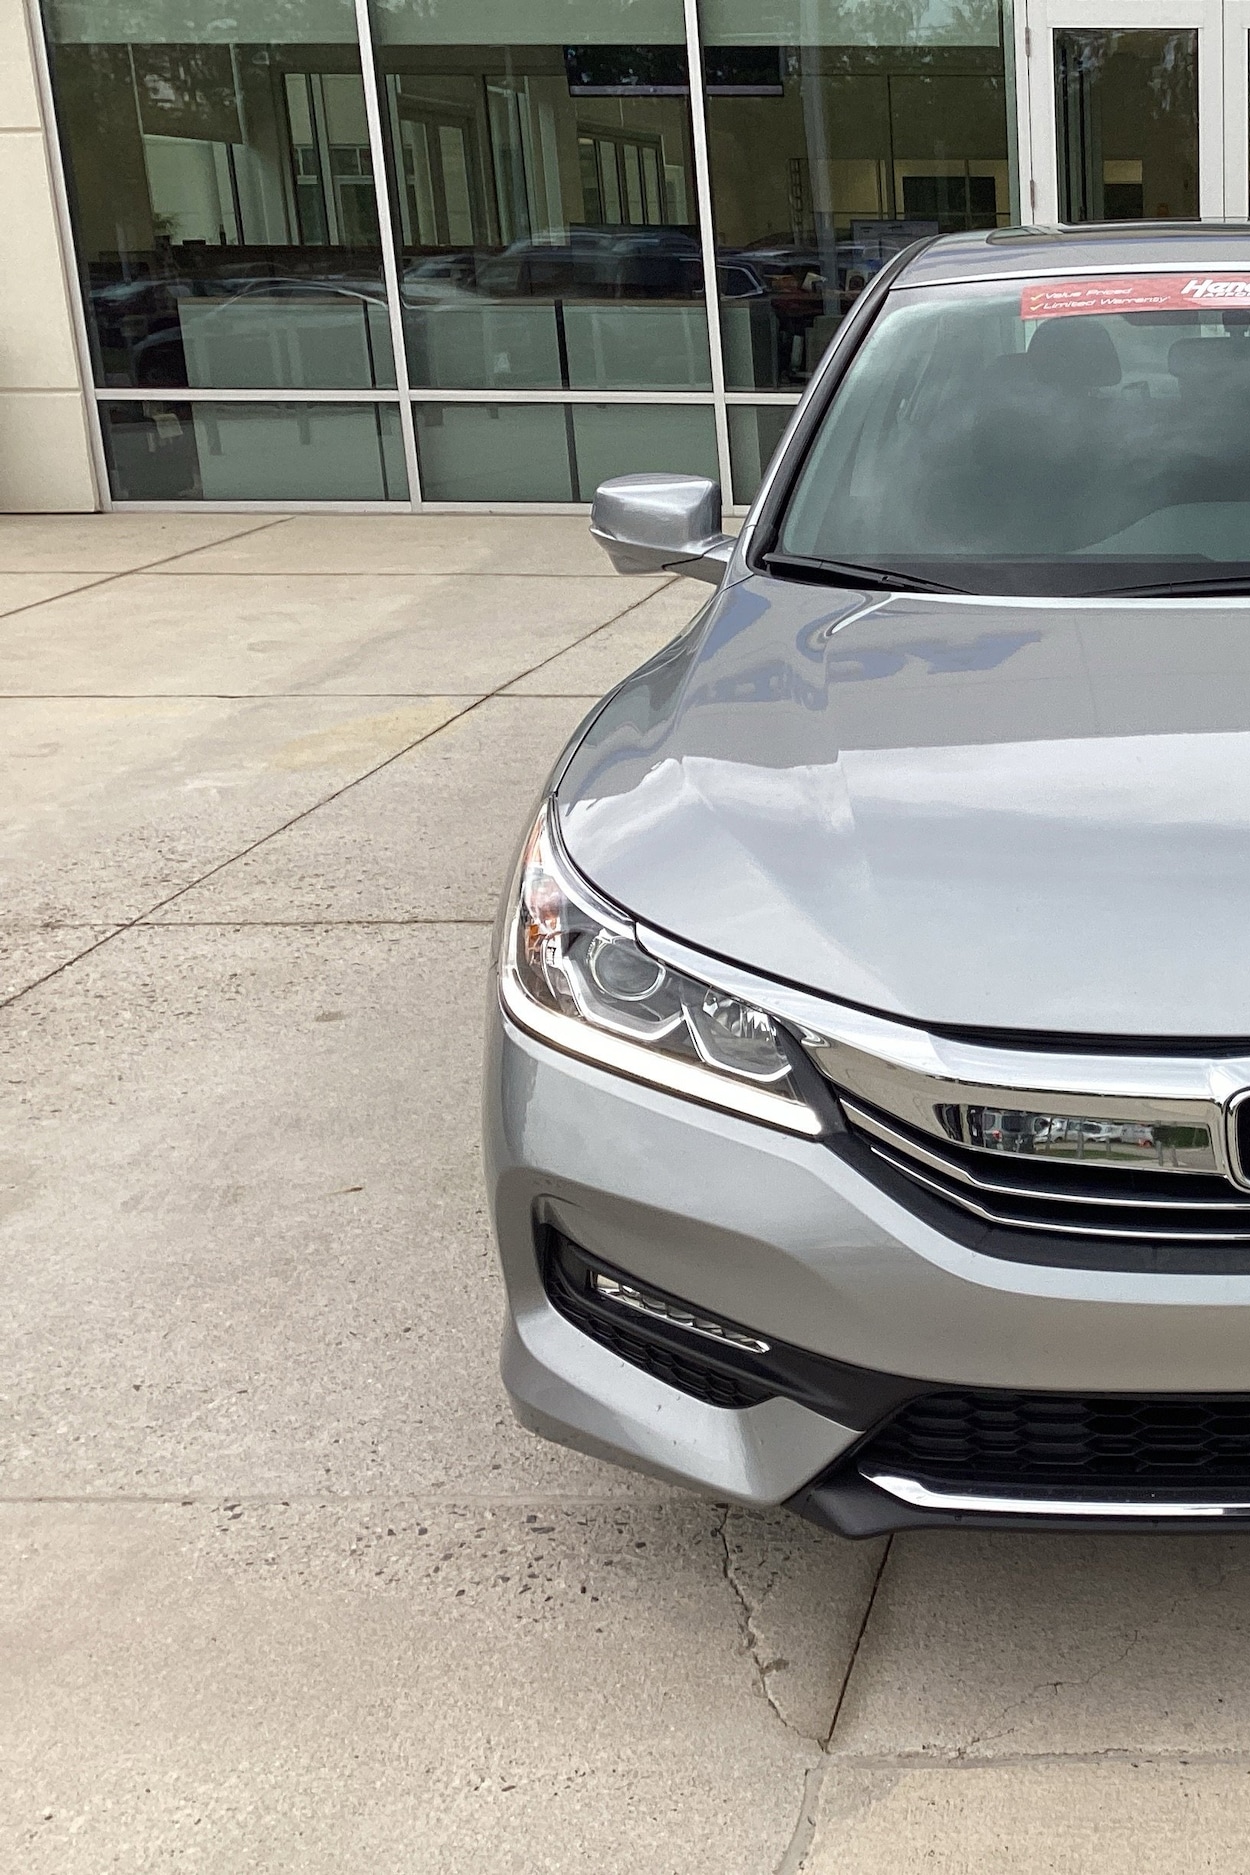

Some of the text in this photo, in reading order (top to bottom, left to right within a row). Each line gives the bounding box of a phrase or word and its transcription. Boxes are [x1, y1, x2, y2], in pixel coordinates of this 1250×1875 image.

[1045, 287, 1133, 300] Value Priced
[1043, 299, 1096, 310] Limited
